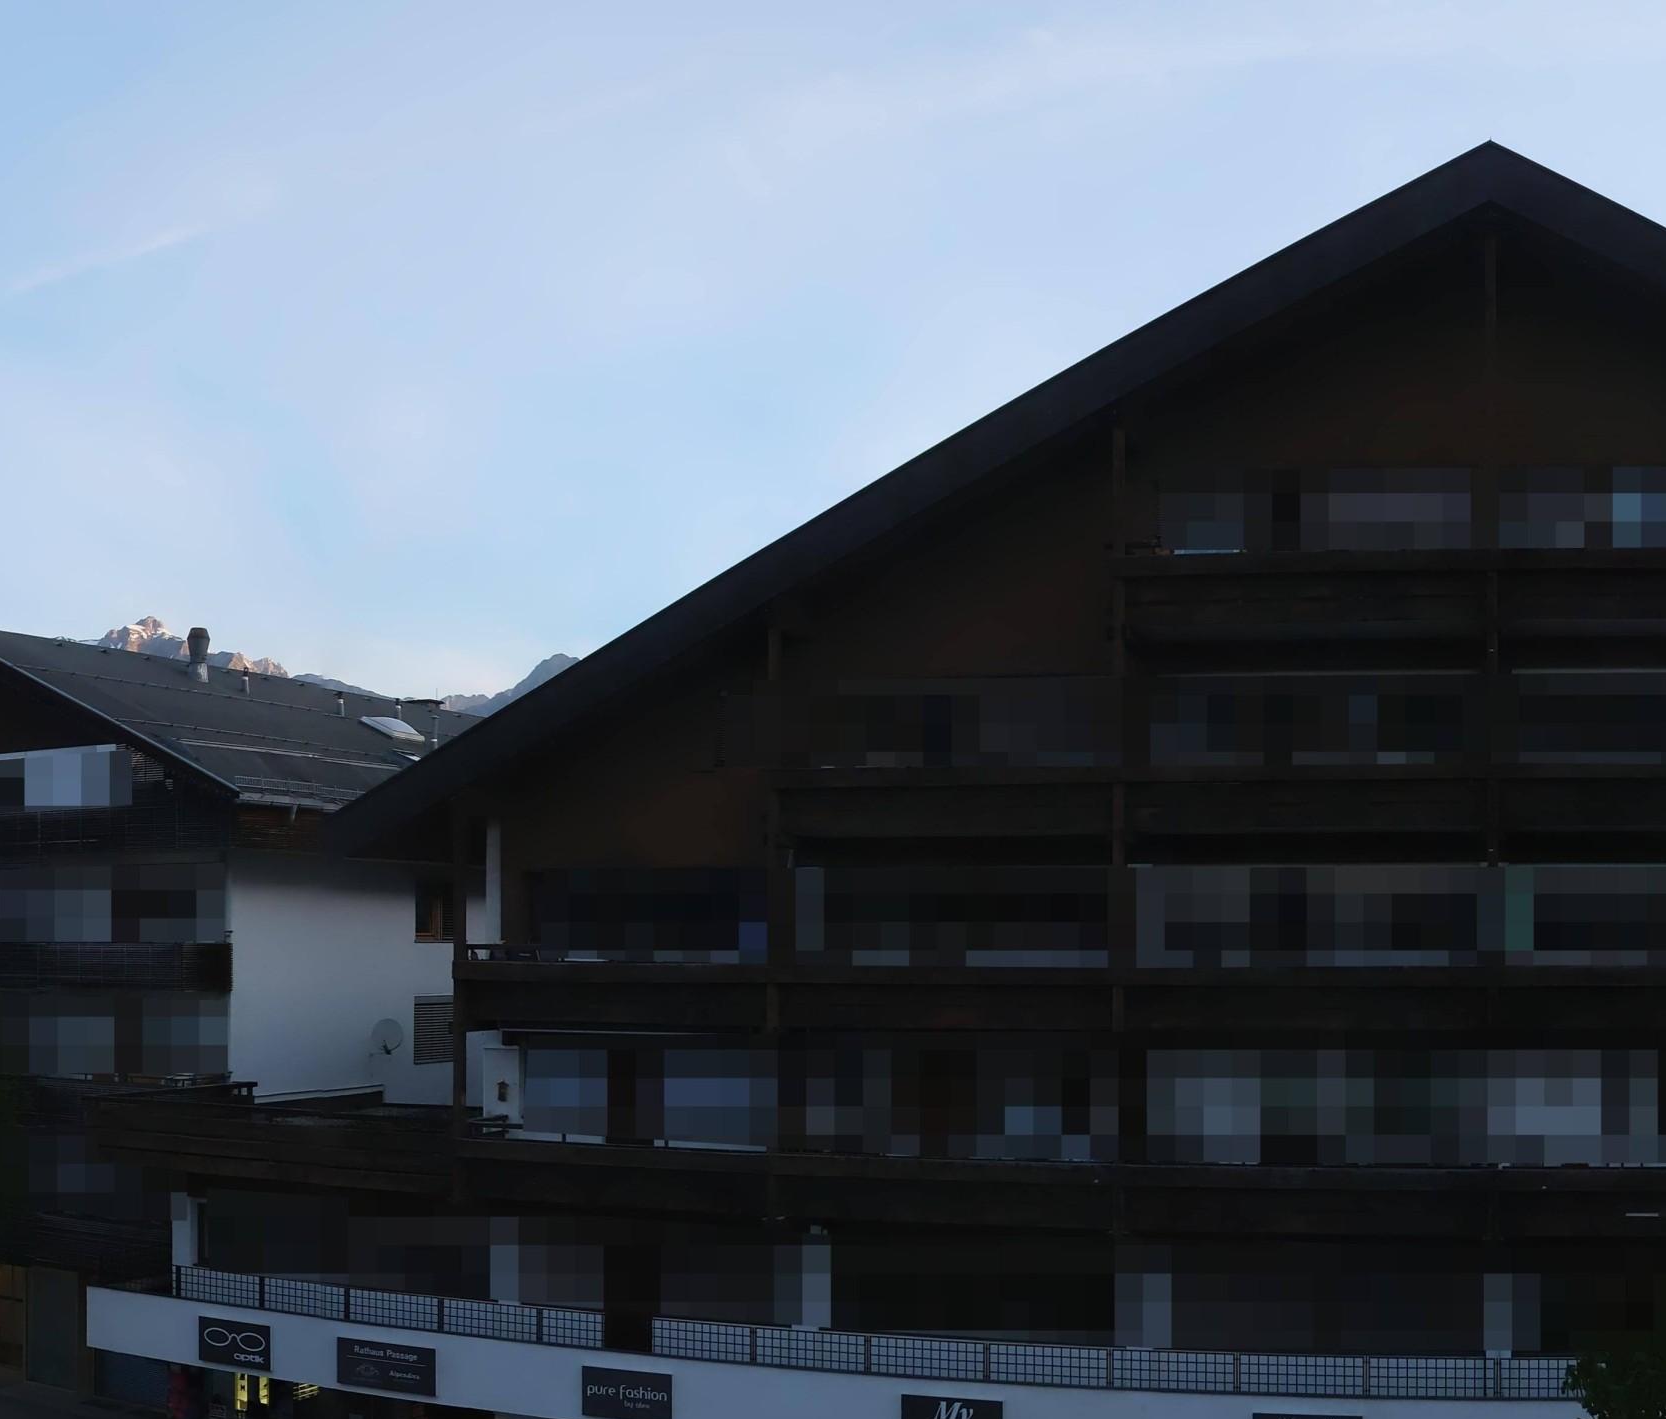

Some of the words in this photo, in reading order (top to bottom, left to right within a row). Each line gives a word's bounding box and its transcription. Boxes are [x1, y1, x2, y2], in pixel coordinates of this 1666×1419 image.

[233, 1352, 265, 1364] optik
[354, 1345, 384, 1357] Rathaus
[386, 1349, 419, 1361] Passage
[586, 1384, 616, 1397] pure
[619, 1384, 668, 1402] fashion
